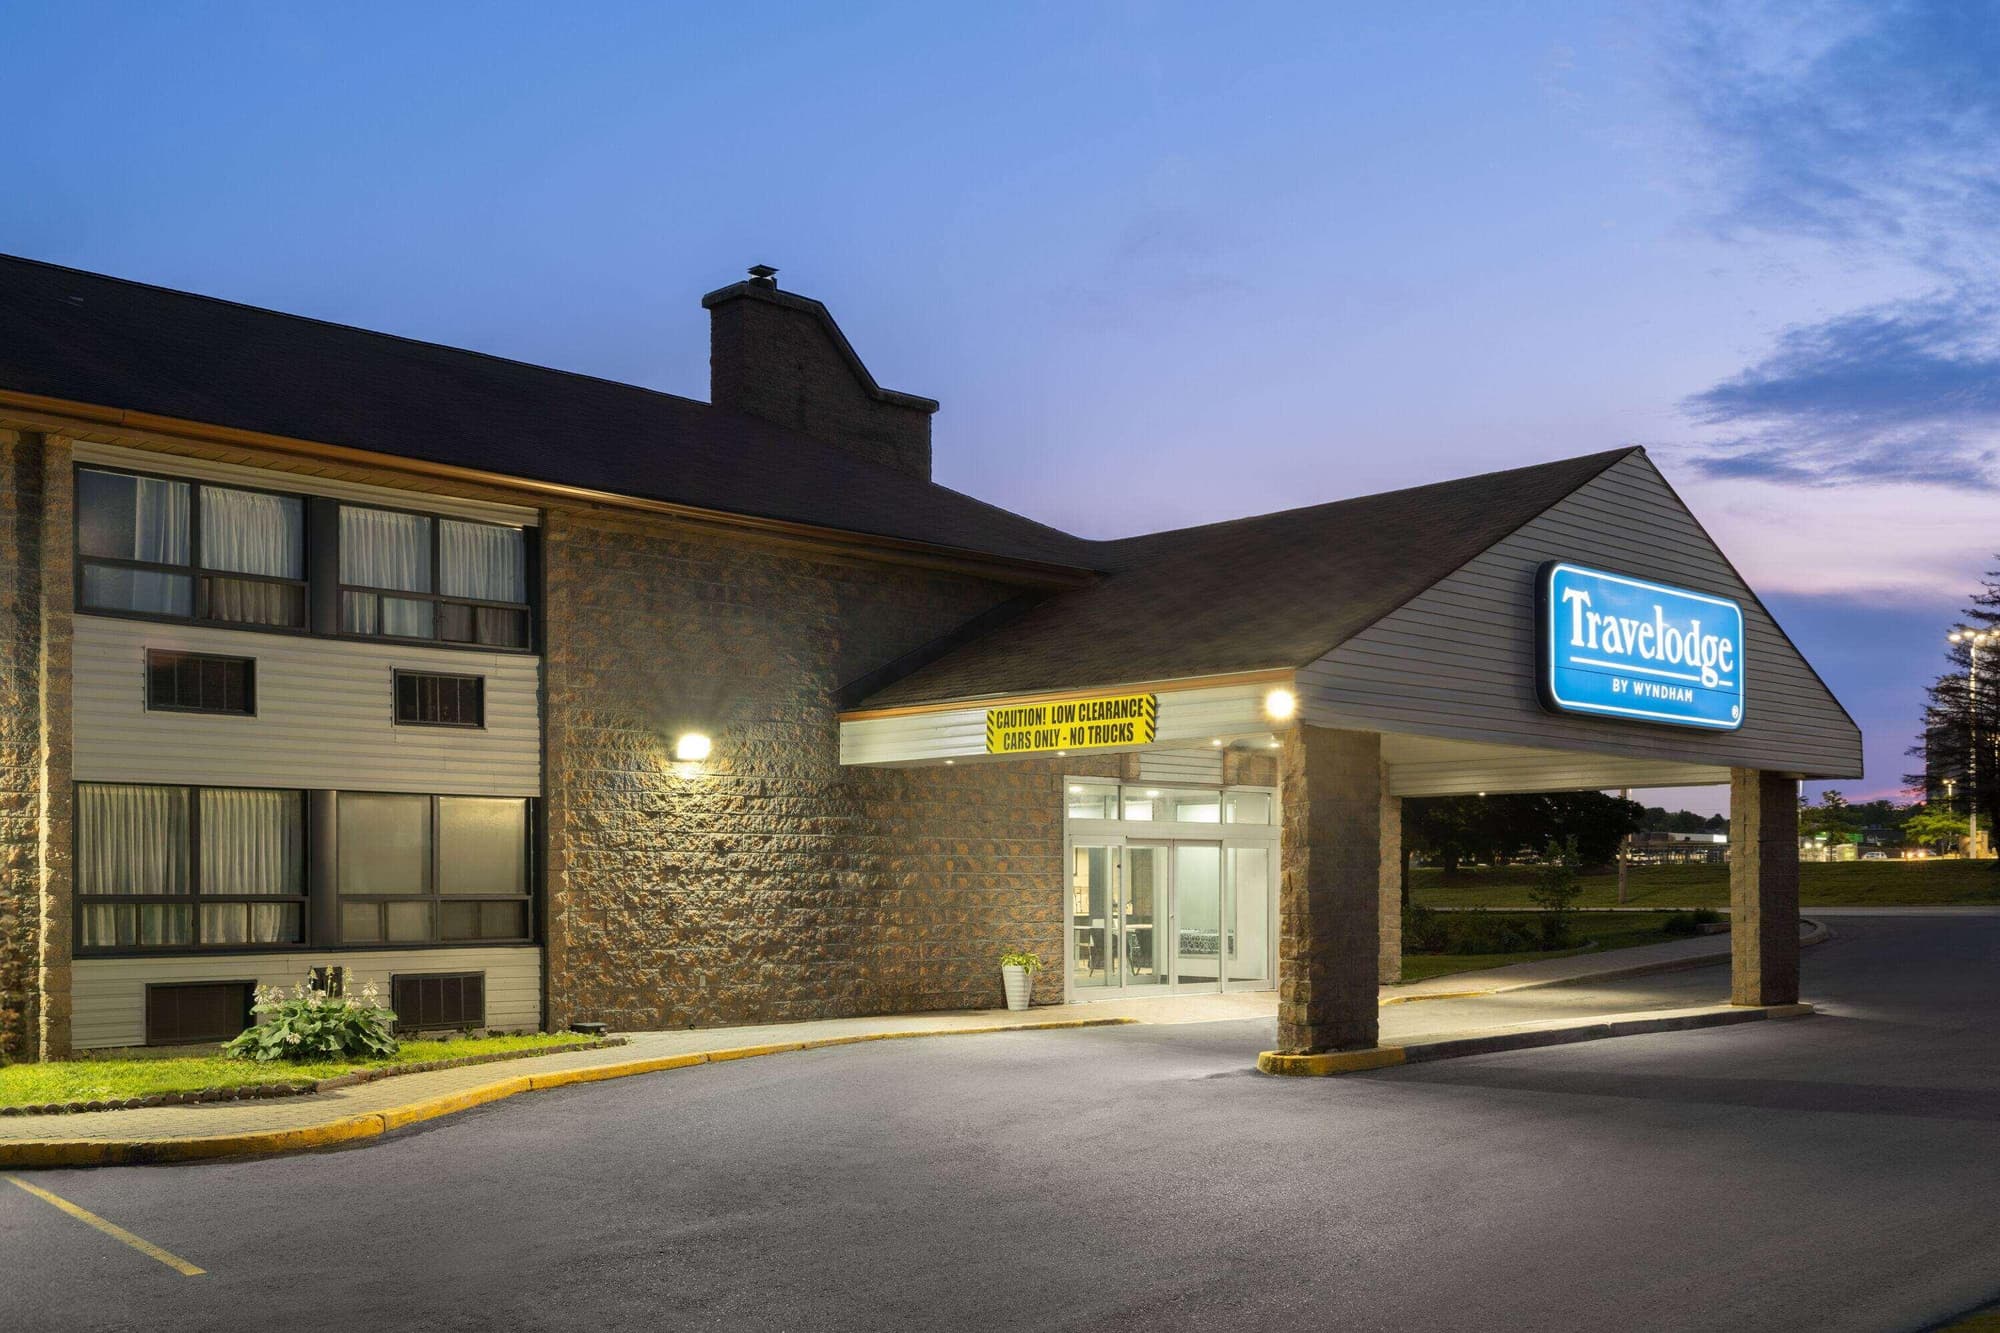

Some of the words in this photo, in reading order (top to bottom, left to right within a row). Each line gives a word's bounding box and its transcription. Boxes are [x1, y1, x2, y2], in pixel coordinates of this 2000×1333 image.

[1562, 587, 1733, 688] Travelodge
[1612, 678, 1628, 693] BY
[1633, 681, 1693, 703] WYNDHAM
[996, 707, 1046, 729] CAUTION!
[1051, 704, 1075, 724] LOW
[1078, 698, 1143, 722] CLEARANCE
[1003, 731, 1031, 751] CARS
[1034, 728, 1061, 748] ONLY
[1069, 726, 1085, 746] NO
[1087, 722, 1134, 744] TRUCKS
